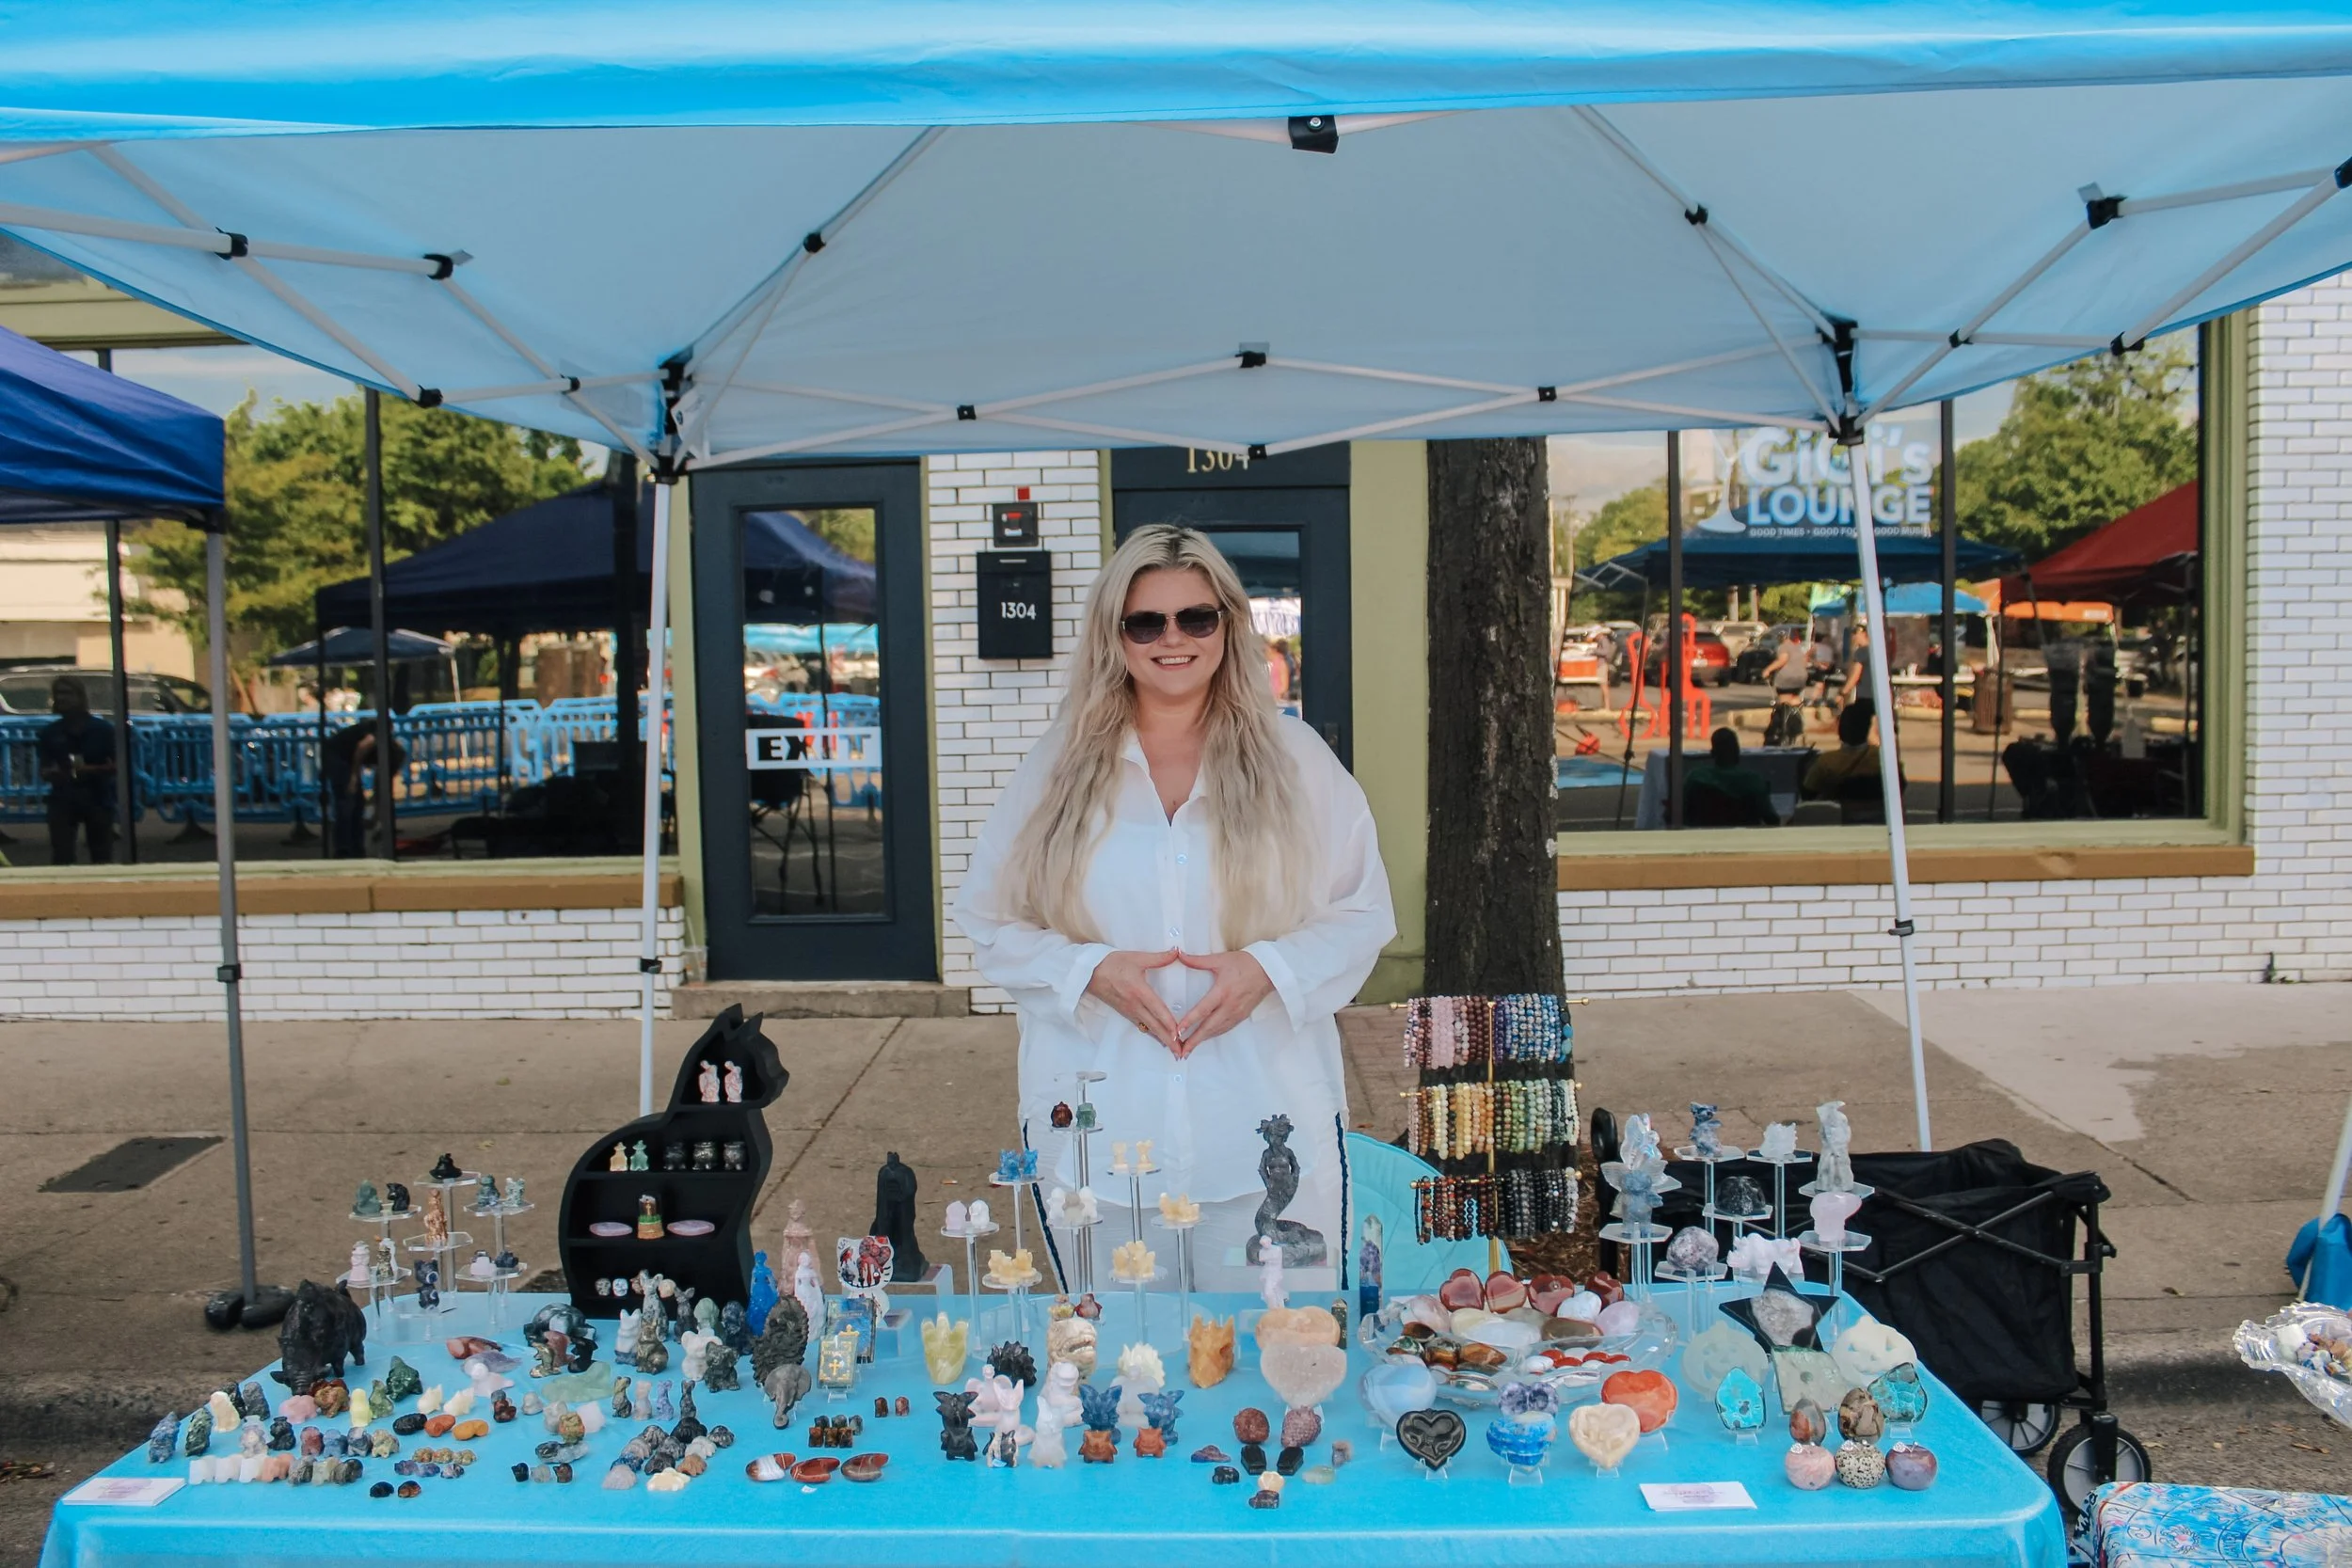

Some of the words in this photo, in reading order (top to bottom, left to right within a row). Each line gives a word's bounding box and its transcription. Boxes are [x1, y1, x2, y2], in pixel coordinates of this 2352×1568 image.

[1750, 527, 1776, 537] GOOD
[1778, 527, 1804, 537] TIMES
[1813, 527, 1839, 536] GOOD
[1840, 527, 1858, 536] FOO
[1873, 527, 1899, 536] GOOD
[1001, 602, 1036, 620] 1304
[757, 734, 871, 761] EXIT
